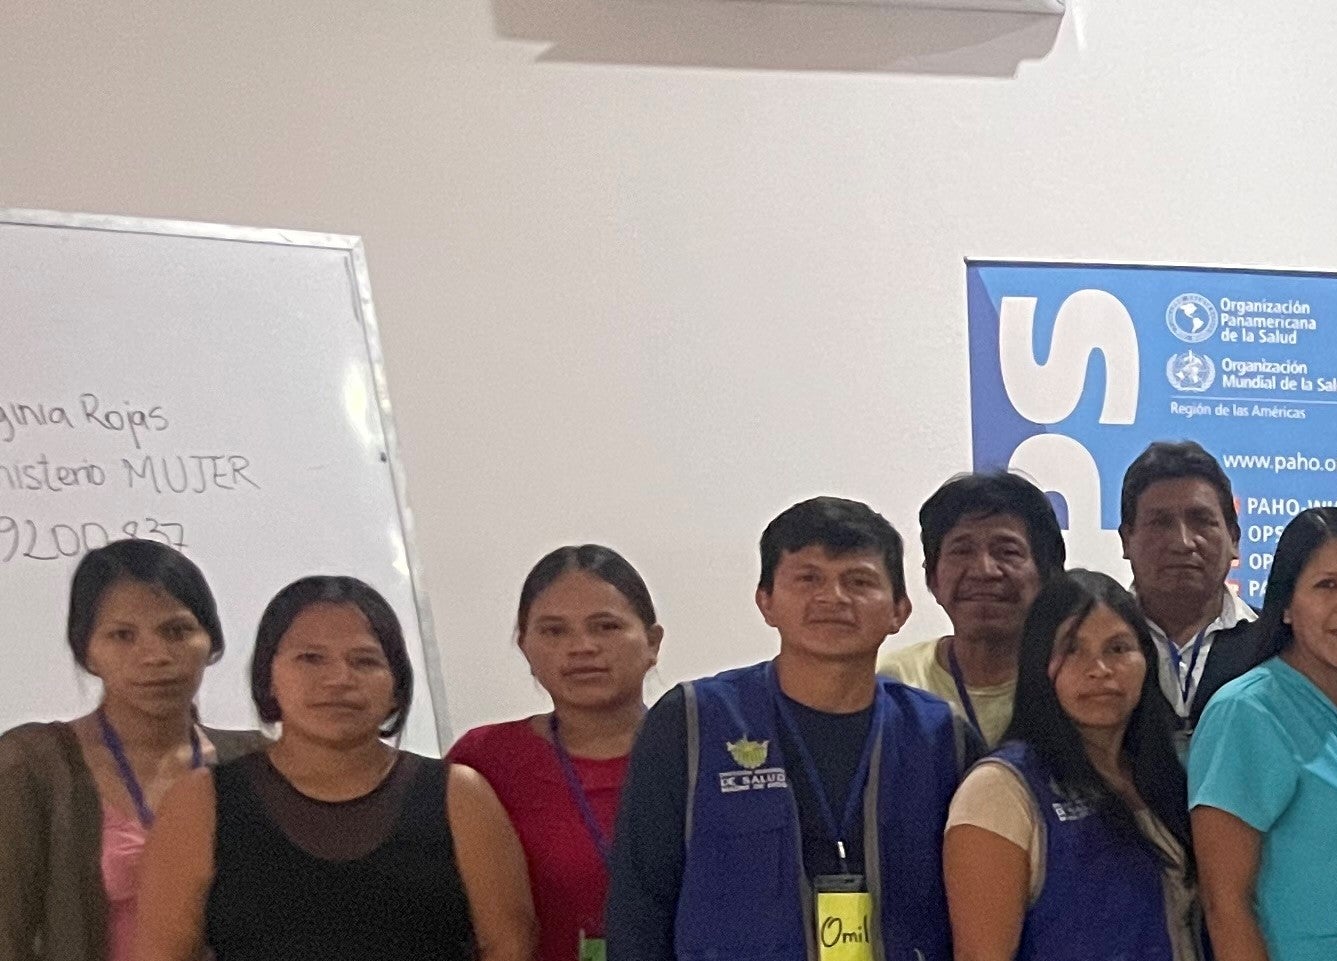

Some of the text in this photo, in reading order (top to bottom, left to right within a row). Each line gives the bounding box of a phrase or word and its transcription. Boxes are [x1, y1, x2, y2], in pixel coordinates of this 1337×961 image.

[1220, 297, 1311, 316] Organización
[1220, 313, 1317, 331] Panamericana
[1220, 327, 1297, 345] de la Salud
[1221, 357, 1308, 376] Organización
[1222, 374, 1276, 390] Mundial
[1280, 375, 1298, 391] de
[1301, 376, 1313, 391] la
[1170, 401, 1306, 419] Región de las Américas
[79, 392, 169, 449] Rojas
[122, 455, 261, 494] MUJER
